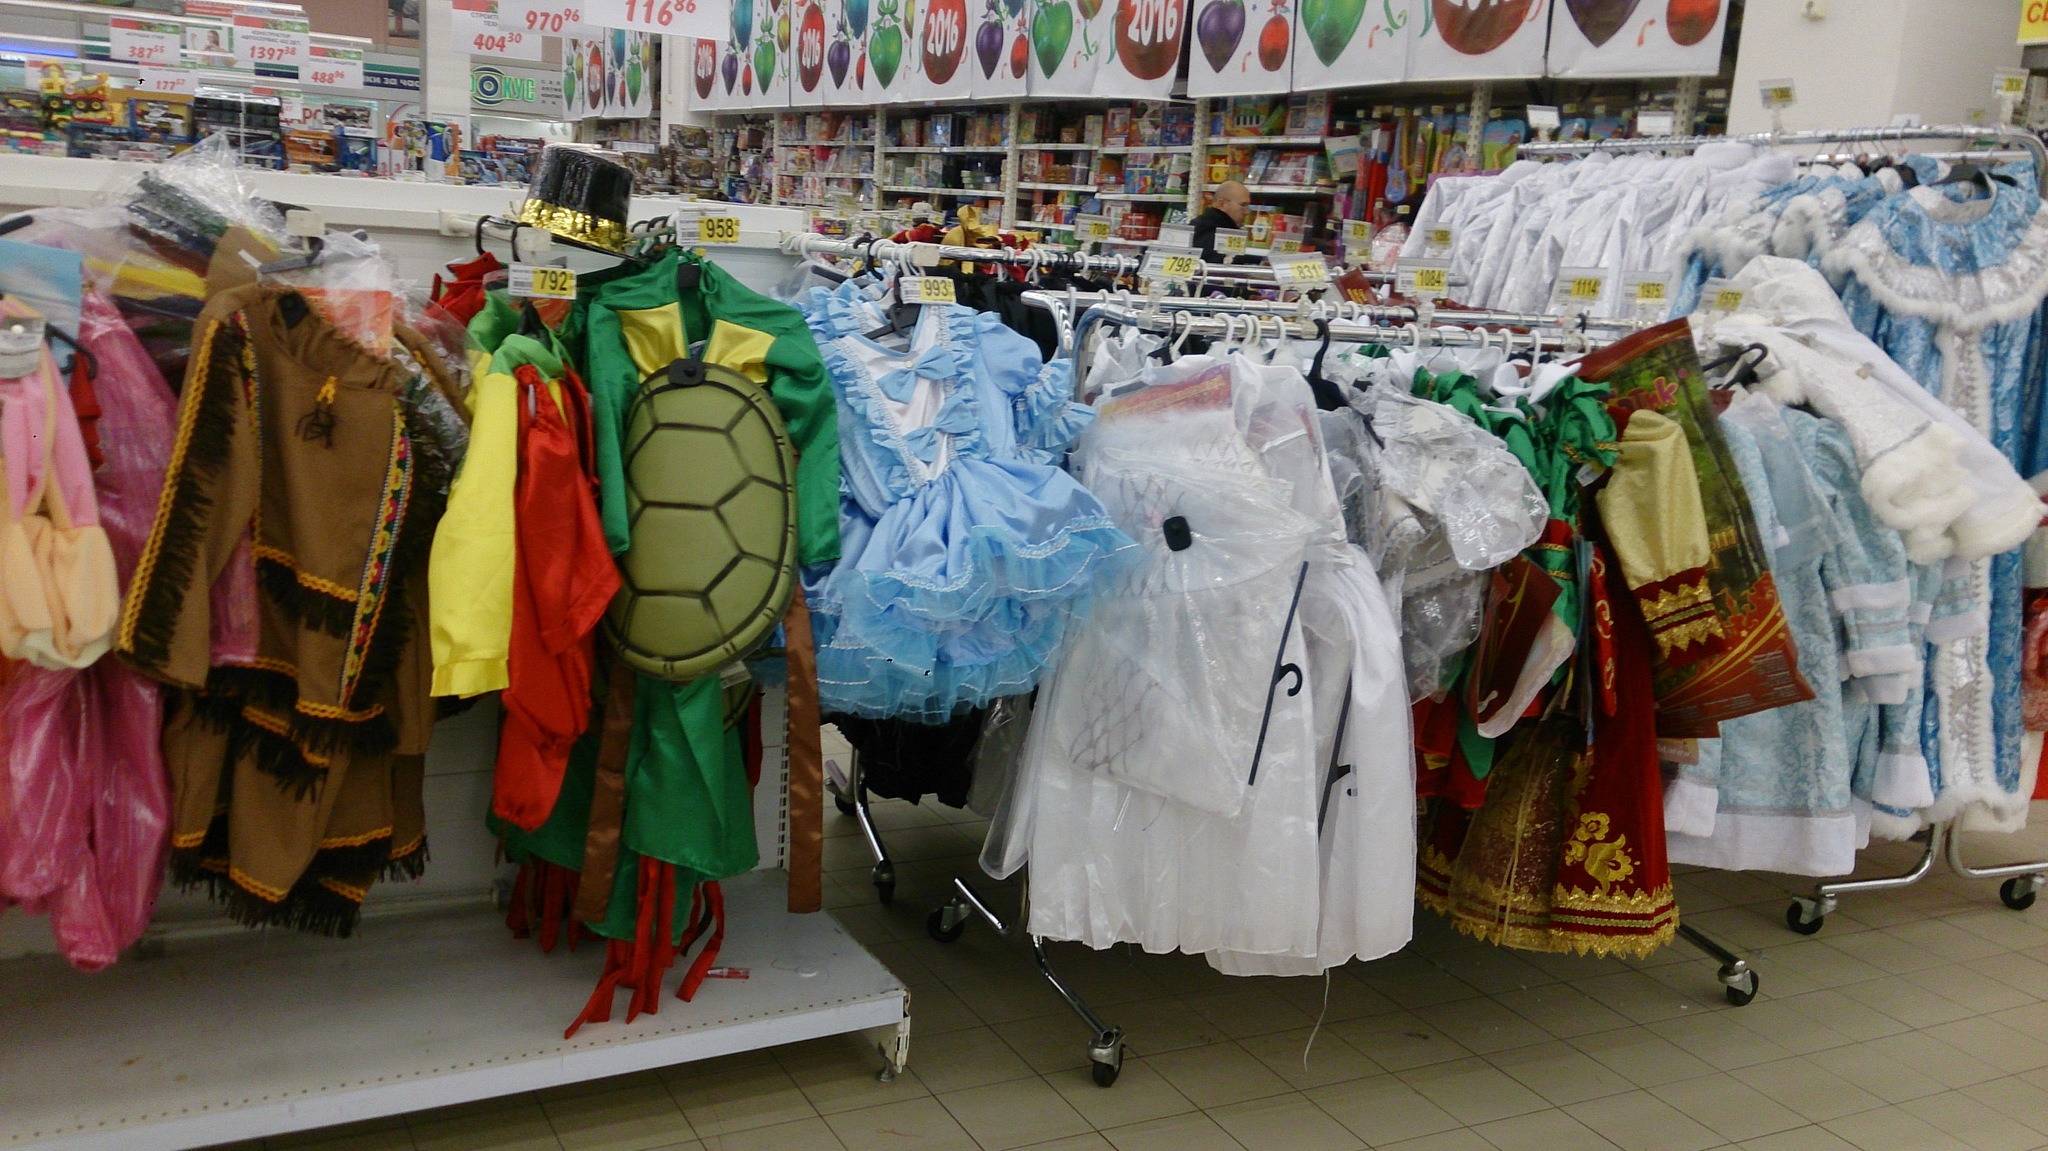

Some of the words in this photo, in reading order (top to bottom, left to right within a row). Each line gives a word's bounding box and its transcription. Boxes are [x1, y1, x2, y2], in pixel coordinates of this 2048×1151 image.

[525, 10, 563, 33] 970
[1127, 0, 1178, 46] 2016
[927, 8, 958, 57] 2016
[129, 46, 153, 58] 387
[473, 33, 506, 52] 404
[801, 28, 820, 69] 2016
[250, 45, 284, 61] 1397
[311, 71, 334, 84] 488
[705, 218, 735, 238] 958
[1167, 257, 1191, 274] 798
[1296, 264, 1320, 280] 831
[539, 270, 567, 291] 792
[924, 279, 949, 297] 993
